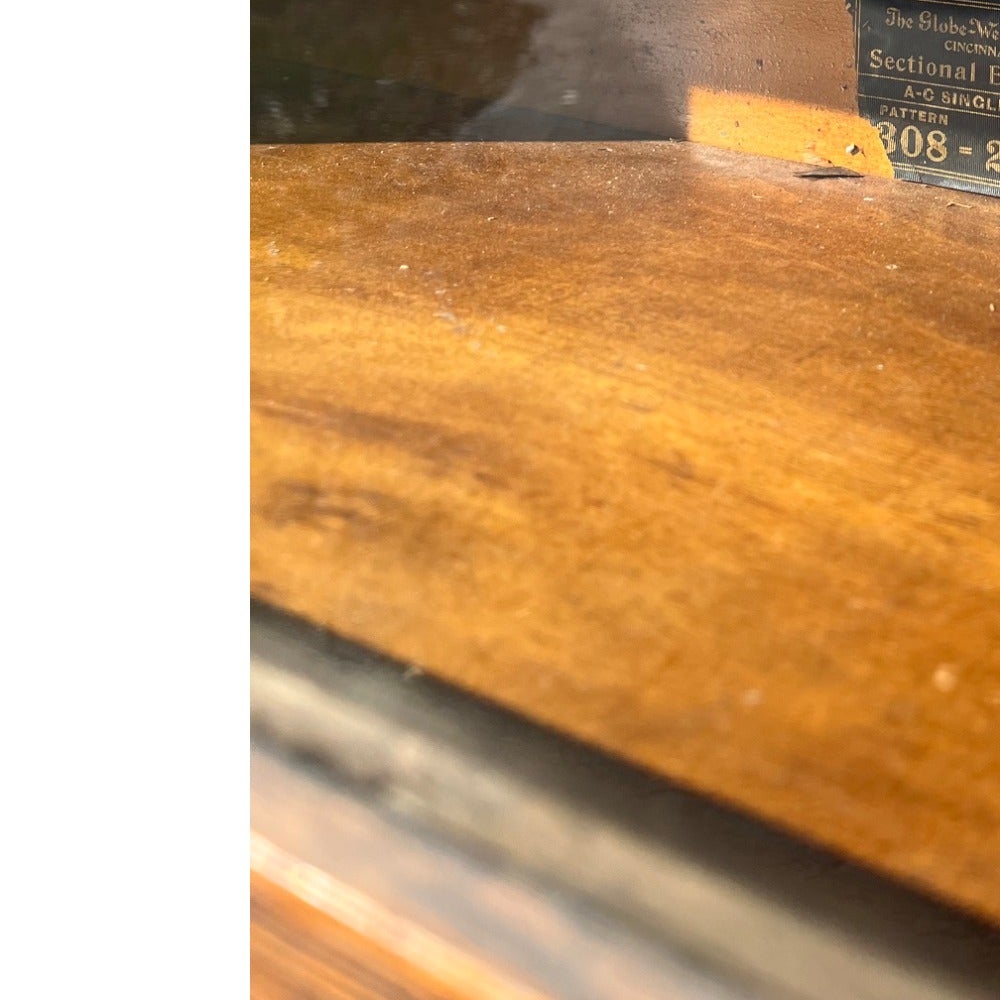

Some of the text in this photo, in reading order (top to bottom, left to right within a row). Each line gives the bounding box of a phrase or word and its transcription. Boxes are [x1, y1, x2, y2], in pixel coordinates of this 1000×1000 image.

[885, 7, 914, 30] The
[869, 48, 977, 83] Sectional
[903, 84, 935, 102] A-C
[879, 104, 949, 126] PATTERN
[876, 120, 949, 163] 308
